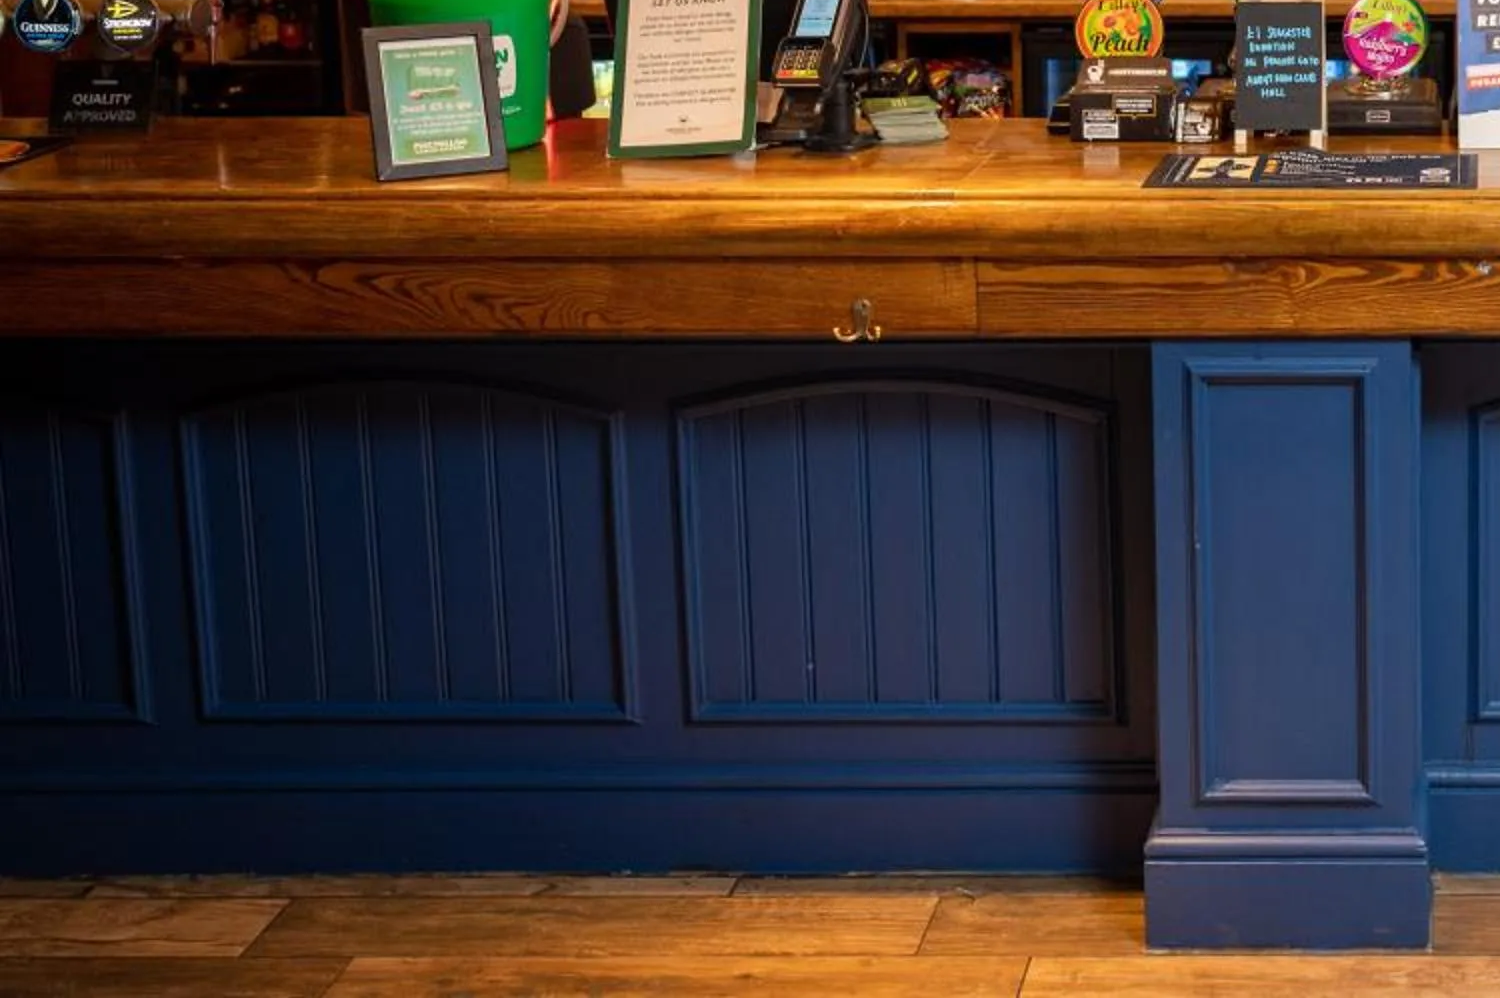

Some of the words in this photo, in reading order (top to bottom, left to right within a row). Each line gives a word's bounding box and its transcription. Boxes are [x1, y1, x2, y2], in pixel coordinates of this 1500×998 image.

[20, 21, 70, 33] GUINNESS
[1089, 30, 1151, 53] Peach
[72, 93, 132, 107] QUALITY
